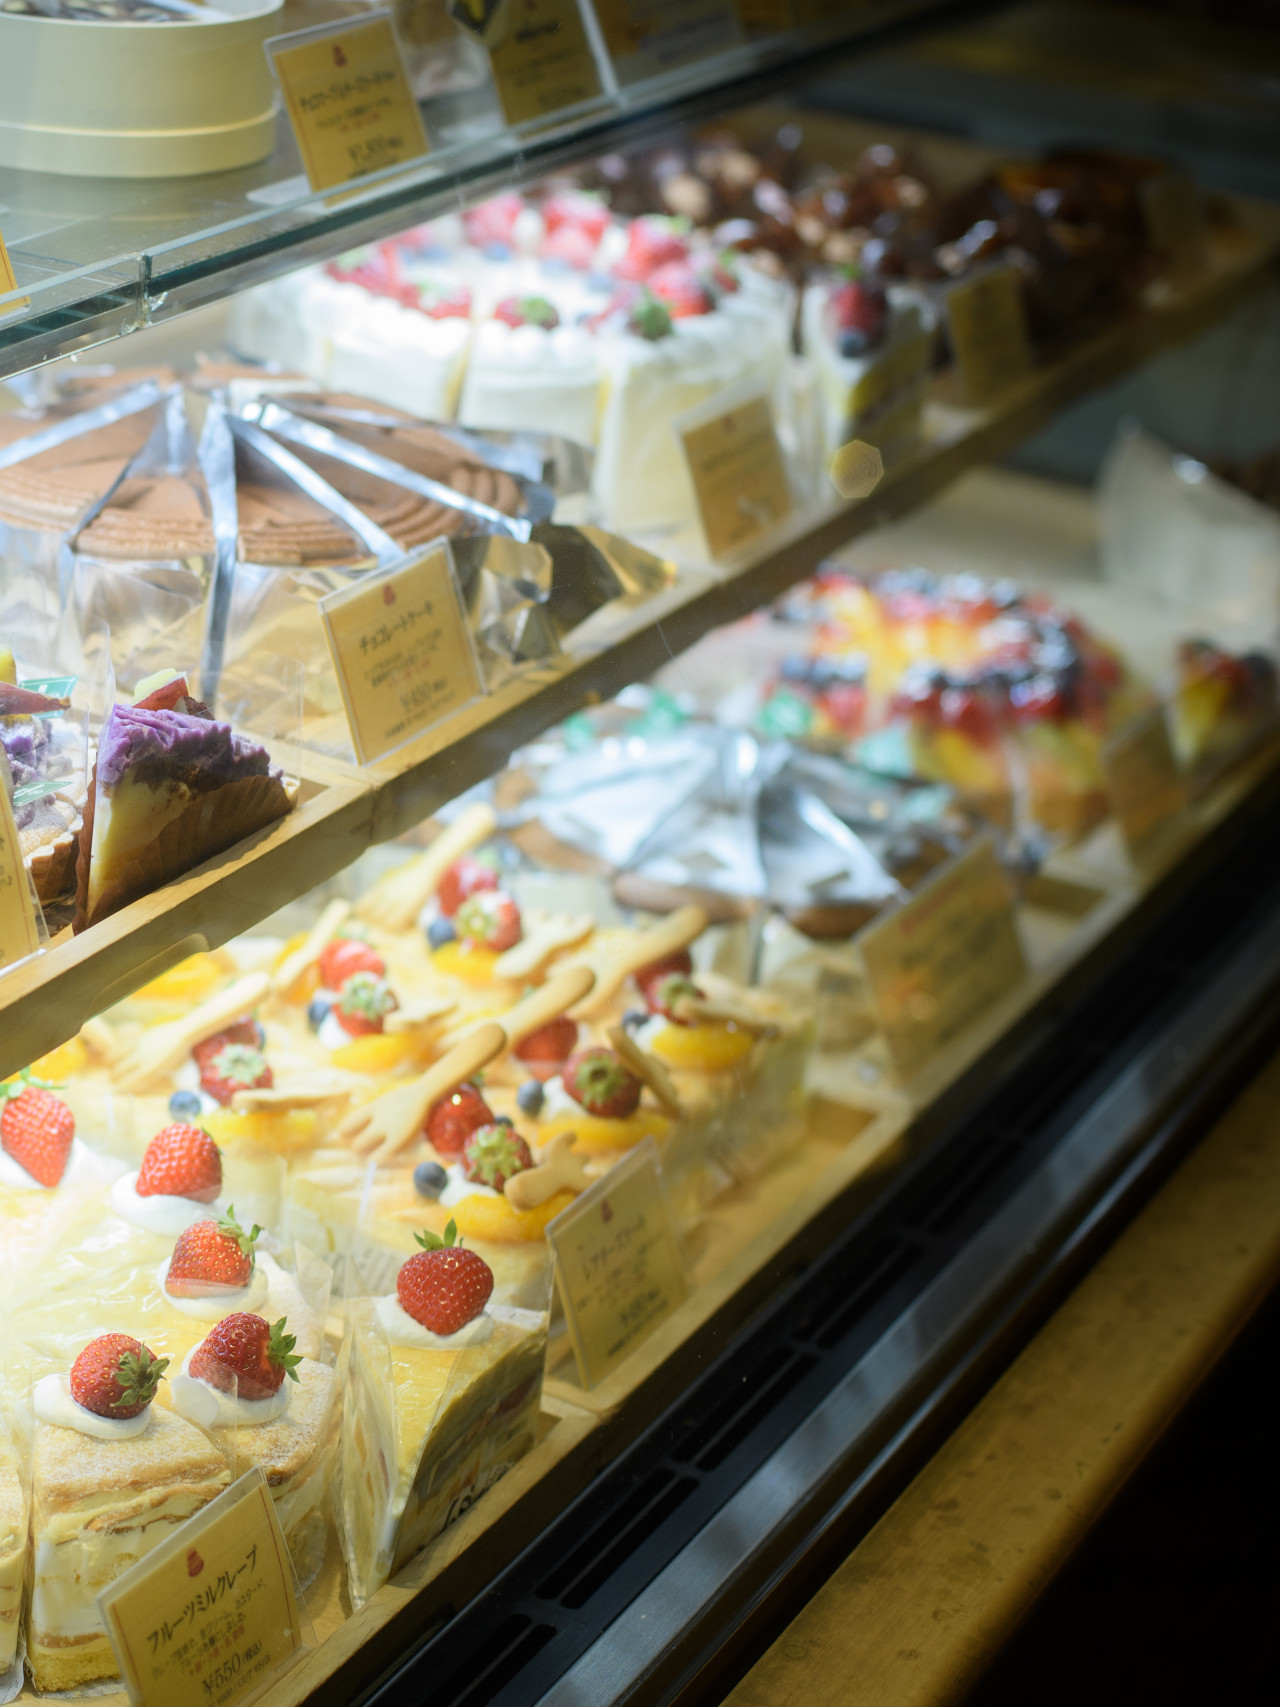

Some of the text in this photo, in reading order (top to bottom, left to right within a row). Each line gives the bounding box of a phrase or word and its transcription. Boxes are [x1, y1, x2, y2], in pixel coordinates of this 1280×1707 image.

[146, 1544, 258, 1655] フルーツミルクレープ
[202, 1651, 242, 1696] ¥550
